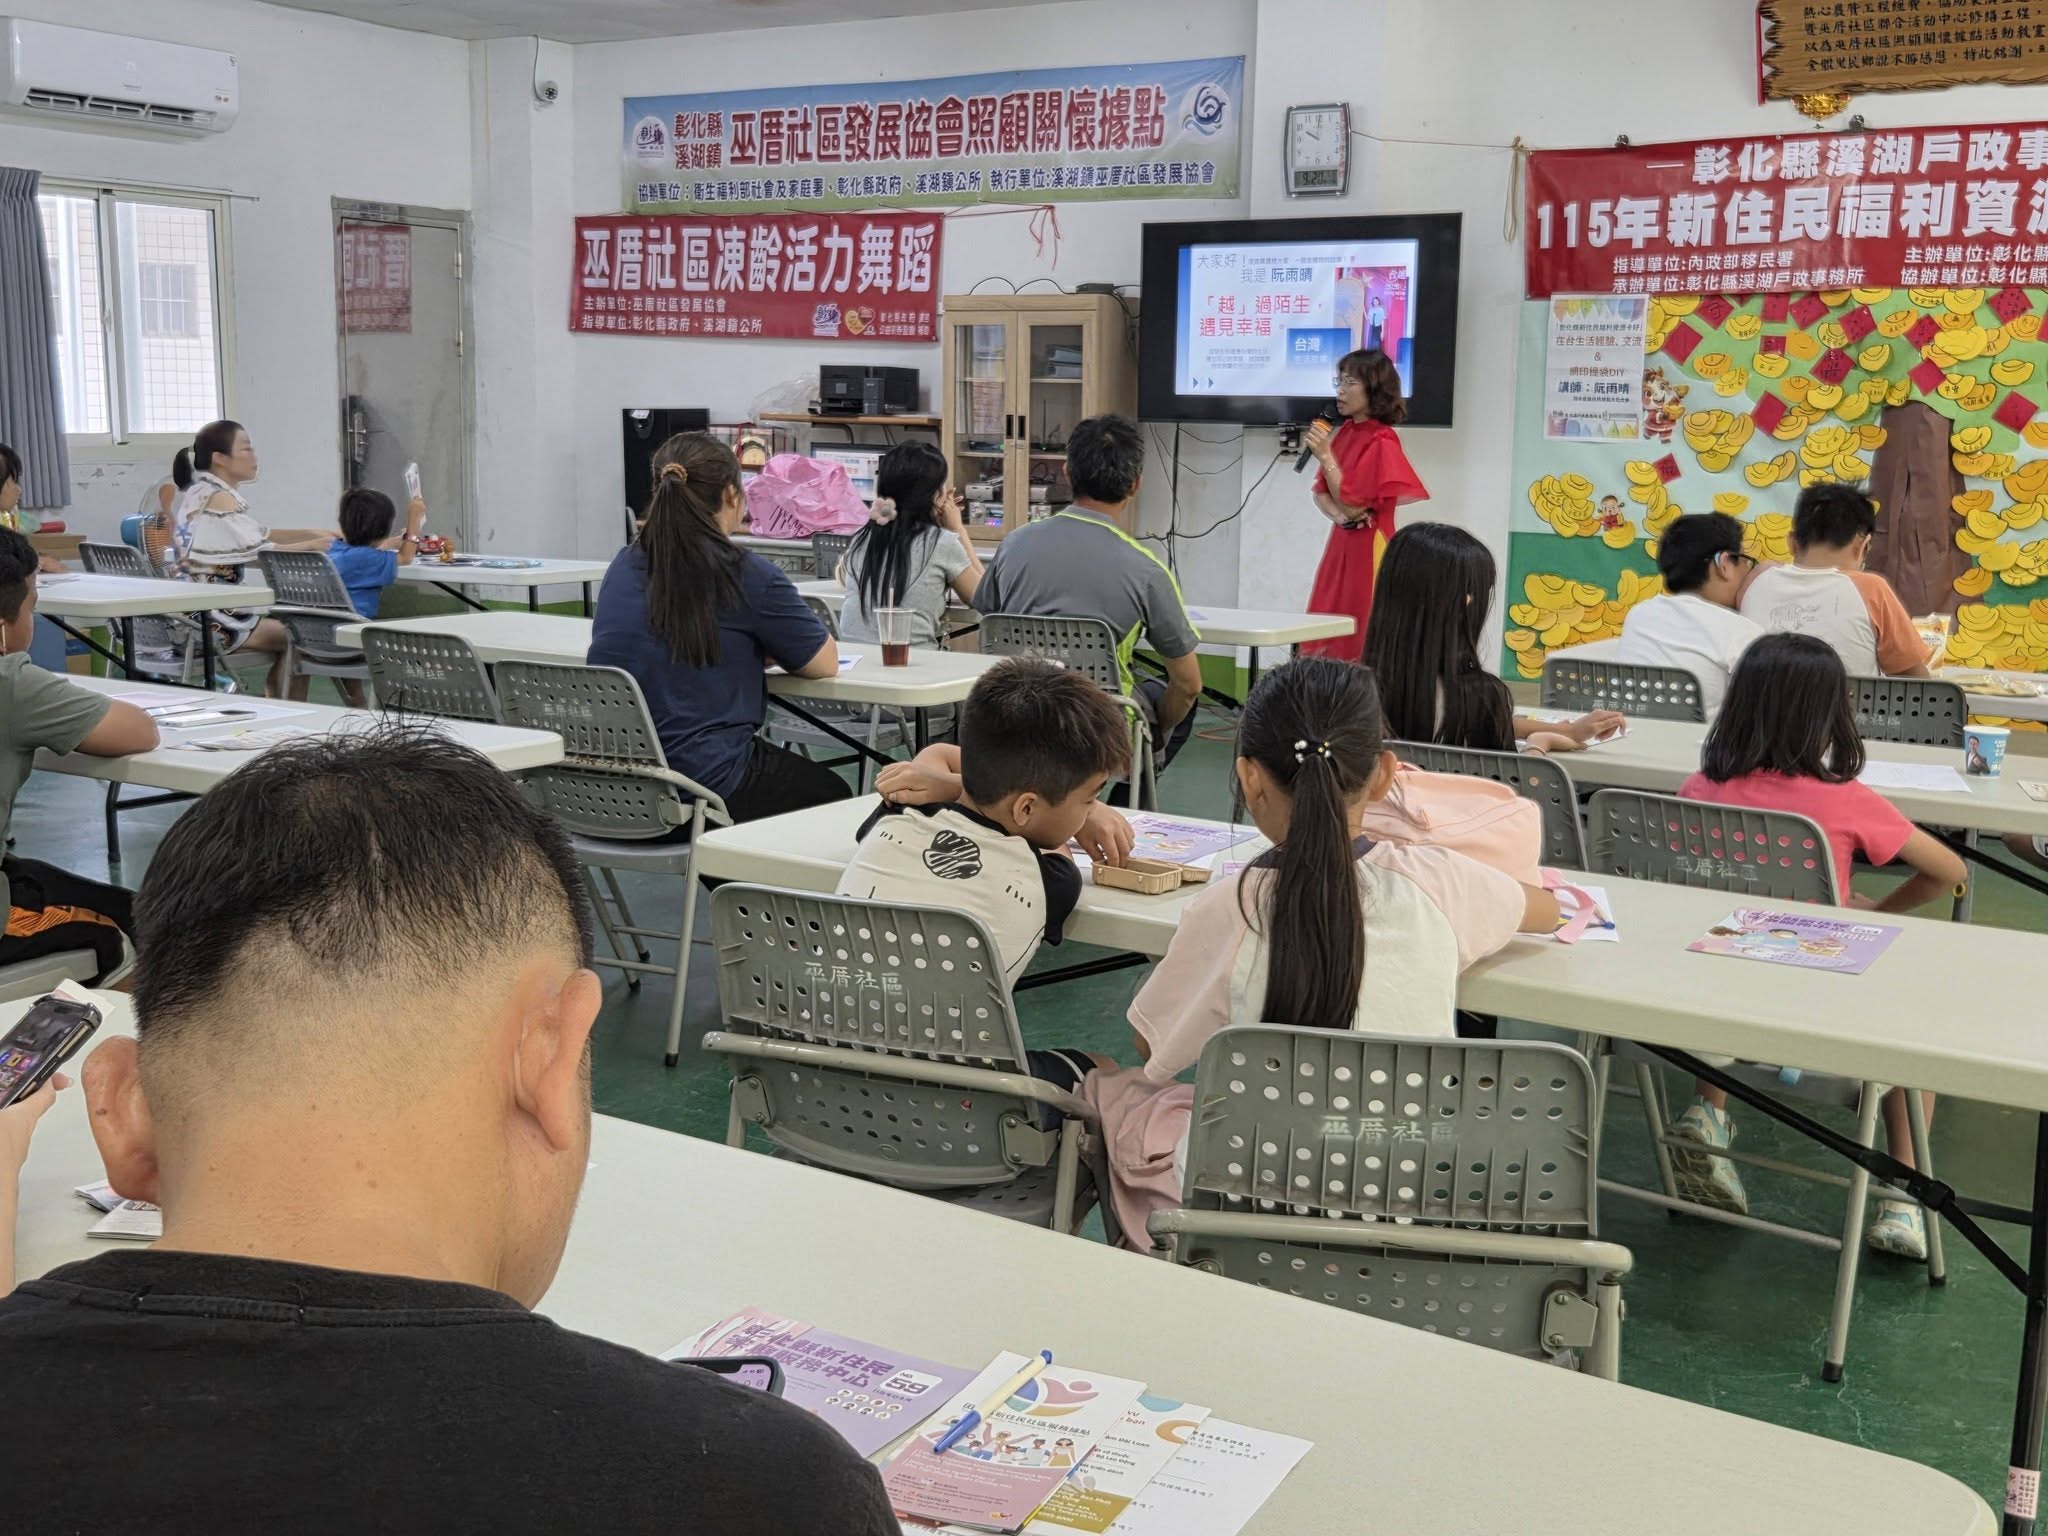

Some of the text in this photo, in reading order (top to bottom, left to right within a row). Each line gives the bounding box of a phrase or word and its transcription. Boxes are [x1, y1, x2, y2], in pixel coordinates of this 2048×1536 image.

[674, 112, 723, 139] 彰化縣
[730, 86, 1167, 166] 巫厝社區發展協會照顧關懷據點
[675, 143, 723, 170] 溪湖鎮
[582, 223, 936, 295] 巫厝社區凍齡活力舞蹈
[885, 1376, 930, 1395] 59
